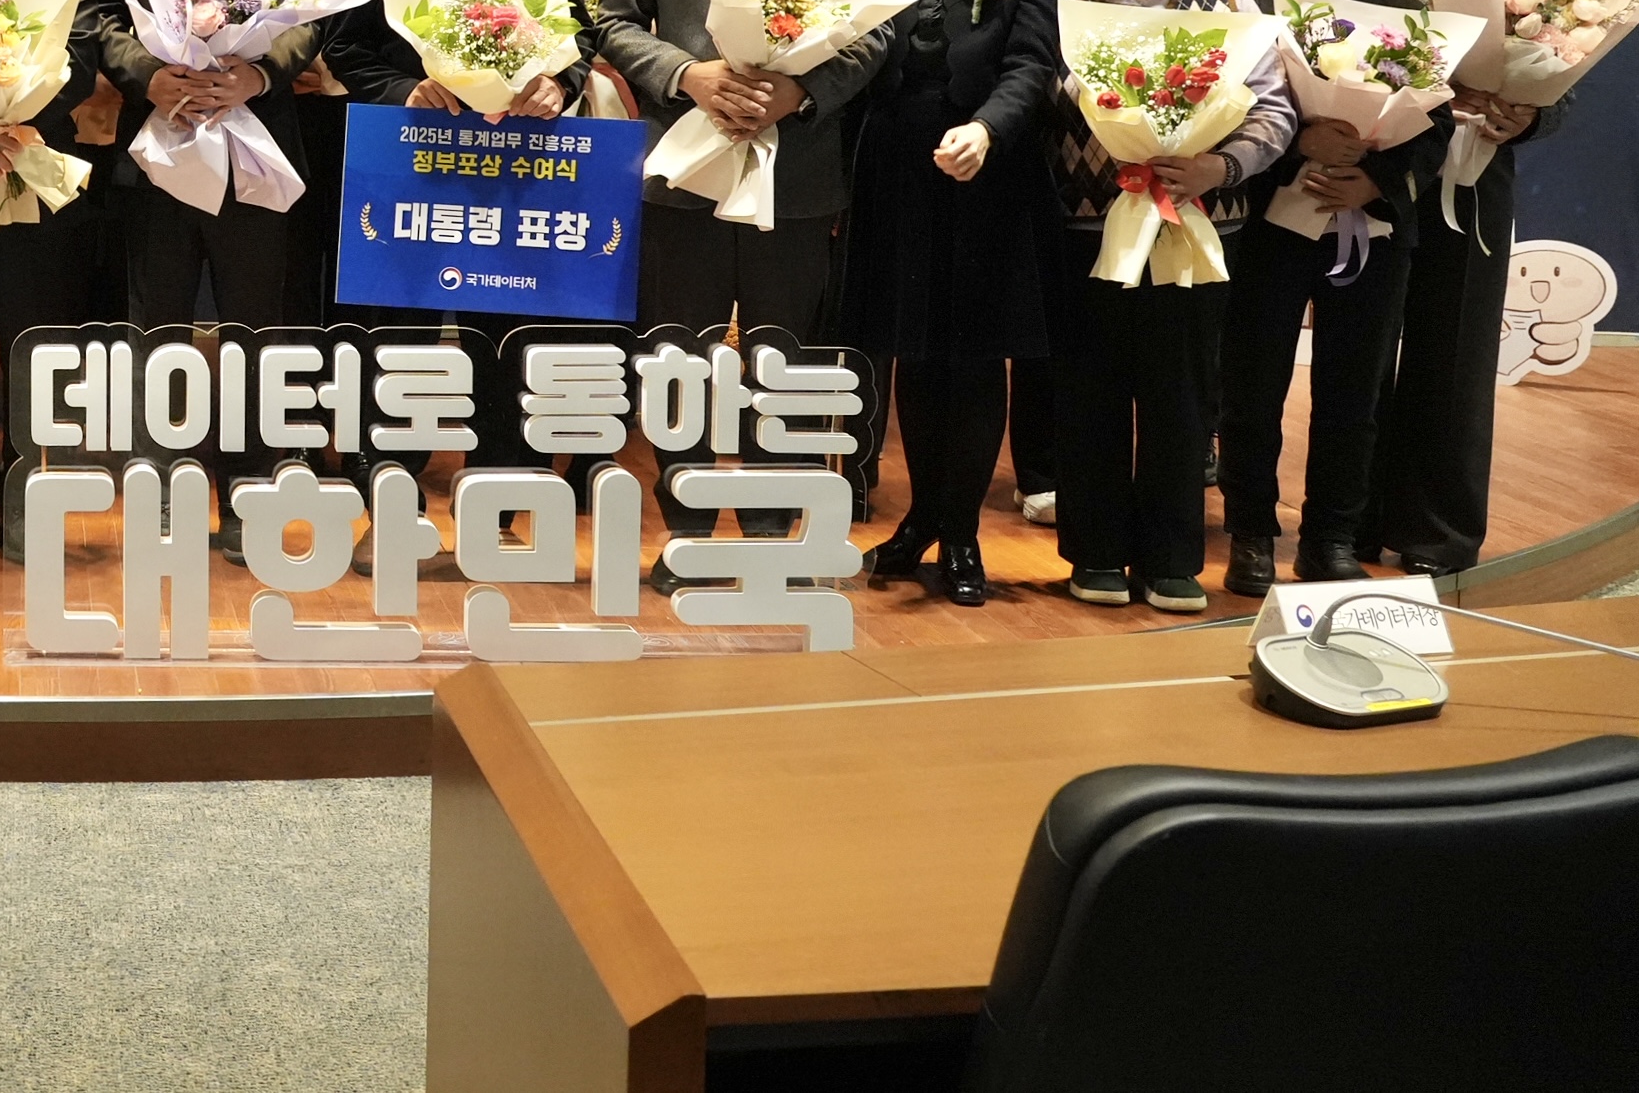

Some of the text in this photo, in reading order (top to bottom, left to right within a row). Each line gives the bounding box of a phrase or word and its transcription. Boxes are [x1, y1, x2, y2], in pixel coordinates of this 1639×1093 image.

[399, 125, 593, 154] 2025년 통계업무 진흥유공
[412, 149, 578, 182] 정부포상 수여식
[392, 201, 591, 252] 대통령 표창
[465, 272, 537, 291] 국가데이터처
[29, 337, 864, 457] 데이터로 통하는
[24, 461, 865, 664] 대한민국
